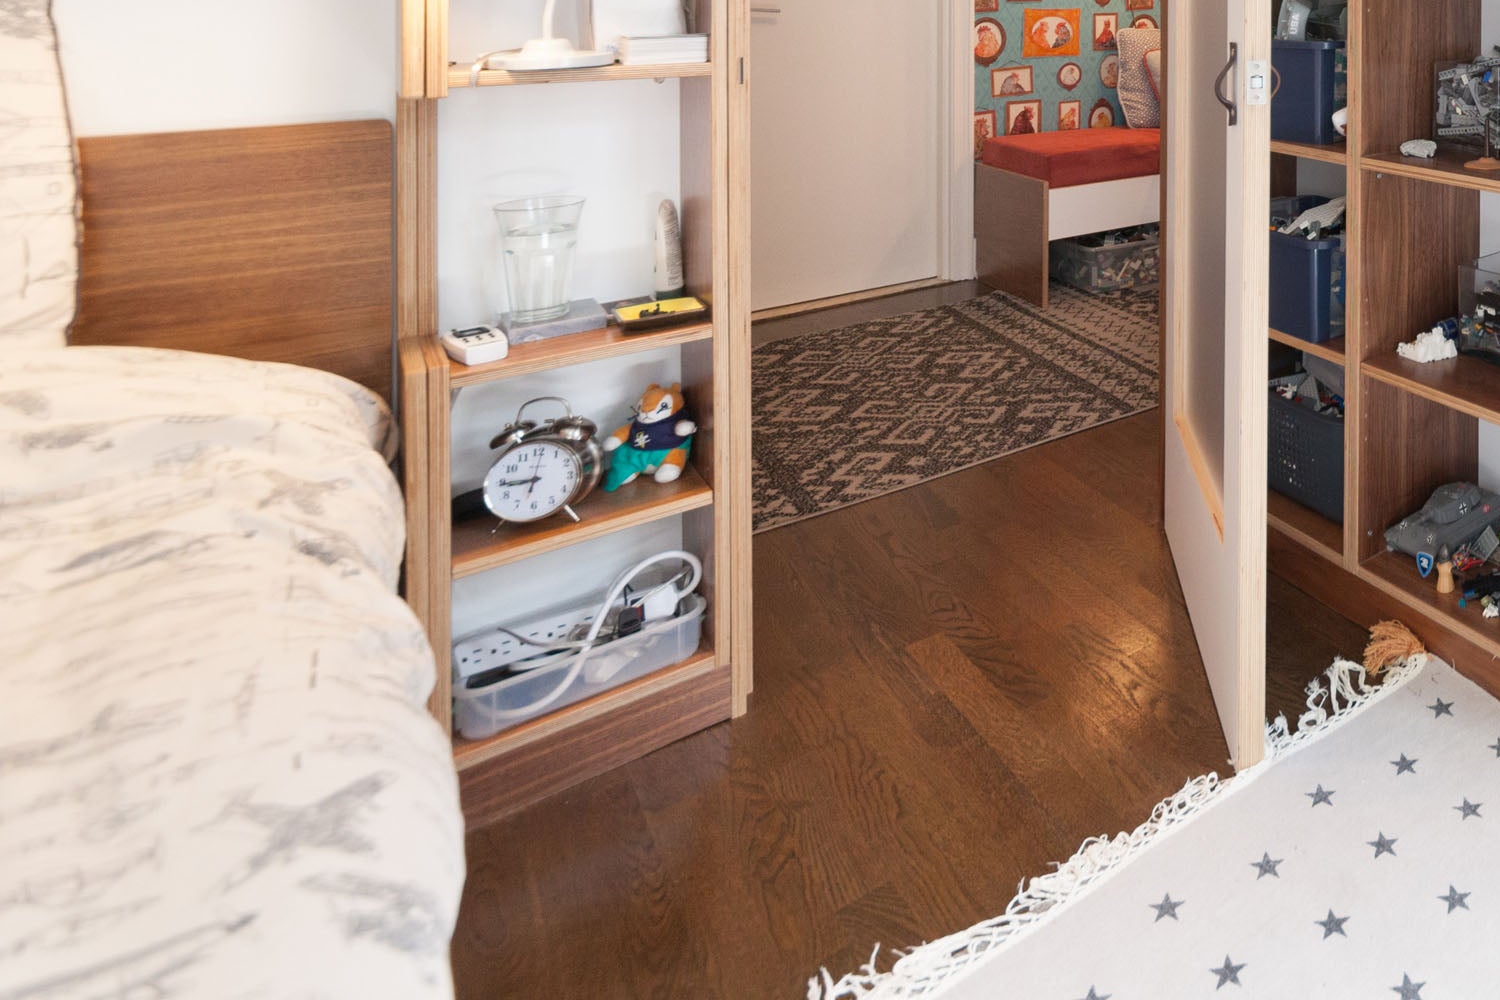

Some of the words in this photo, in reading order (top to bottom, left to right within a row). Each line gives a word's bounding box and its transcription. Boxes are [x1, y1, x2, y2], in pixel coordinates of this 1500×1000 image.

[533, 447, 545, 456] 12
[554, 450, 558, 458] 1
[518, 454, 528, 462] 11
[564, 459, 570, 467] 2
[506, 464, 518, 473] 10
[567, 471, 573, 480] 3
[503, 490, 510, 499] 8
[549, 496, 555, 504] 5
[513, 499, 520, 511] 7
